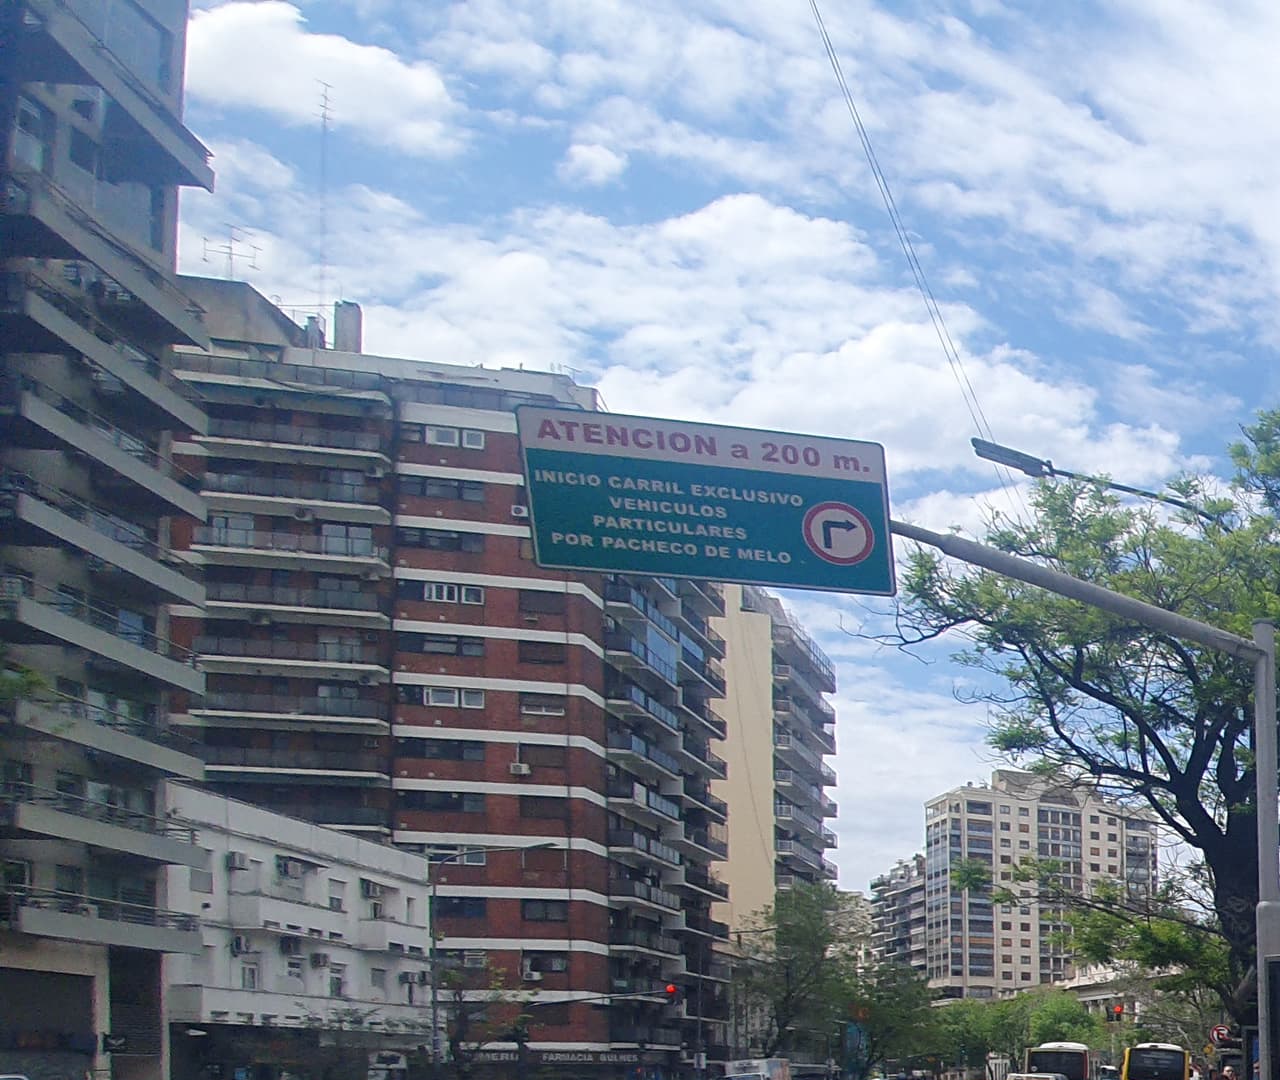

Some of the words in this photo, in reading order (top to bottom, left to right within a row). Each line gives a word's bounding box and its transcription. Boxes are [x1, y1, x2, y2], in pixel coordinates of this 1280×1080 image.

[537, 418, 718, 456] ATENCION
[731, 442, 749, 459] a
[761, 441, 821, 467] 200
[833, 452, 871, 473] m.
[535, 469, 600, 487] INICIO
[608, 476, 684, 495] CARRIL
[691, 484, 803, 507] EXCLUSIVO
[609, 496, 728, 519] VEHICULOS
[593, 515, 748, 541] PARTICULARES
[551, 532, 594, 547] POR
[602, 536, 698, 556] PACHECO
[705, 544, 731, 559] DE
[738, 548, 792, 564] MELO
[542, 1053, 593, 1062] FARMACIA
